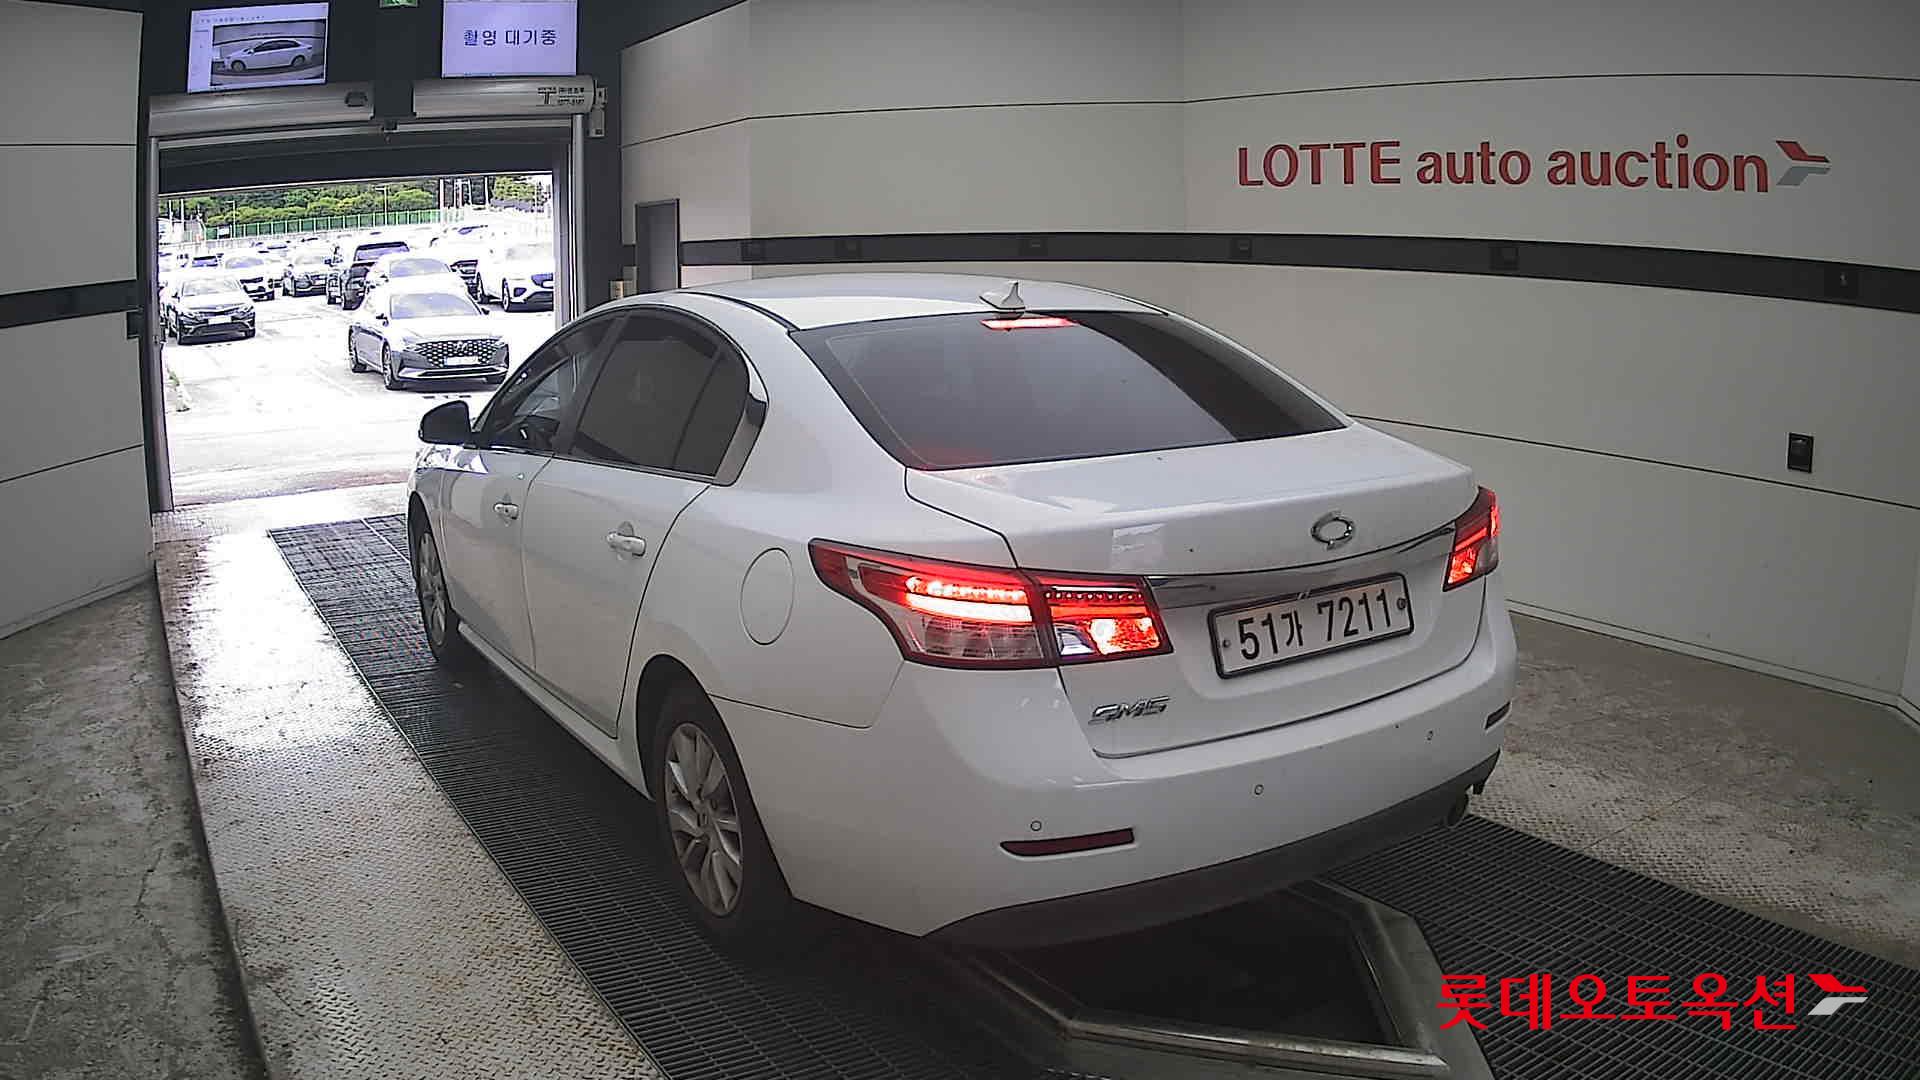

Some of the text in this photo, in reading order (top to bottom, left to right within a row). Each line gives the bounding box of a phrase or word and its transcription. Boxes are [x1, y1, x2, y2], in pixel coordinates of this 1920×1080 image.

[505, 29, 557, 46] 대기중
[1238, 133, 1769, 193] LOTTE auto auction
[1237, 588, 1392, 660] 51가 7211
[1088, 695, 1171, 725] SM5
